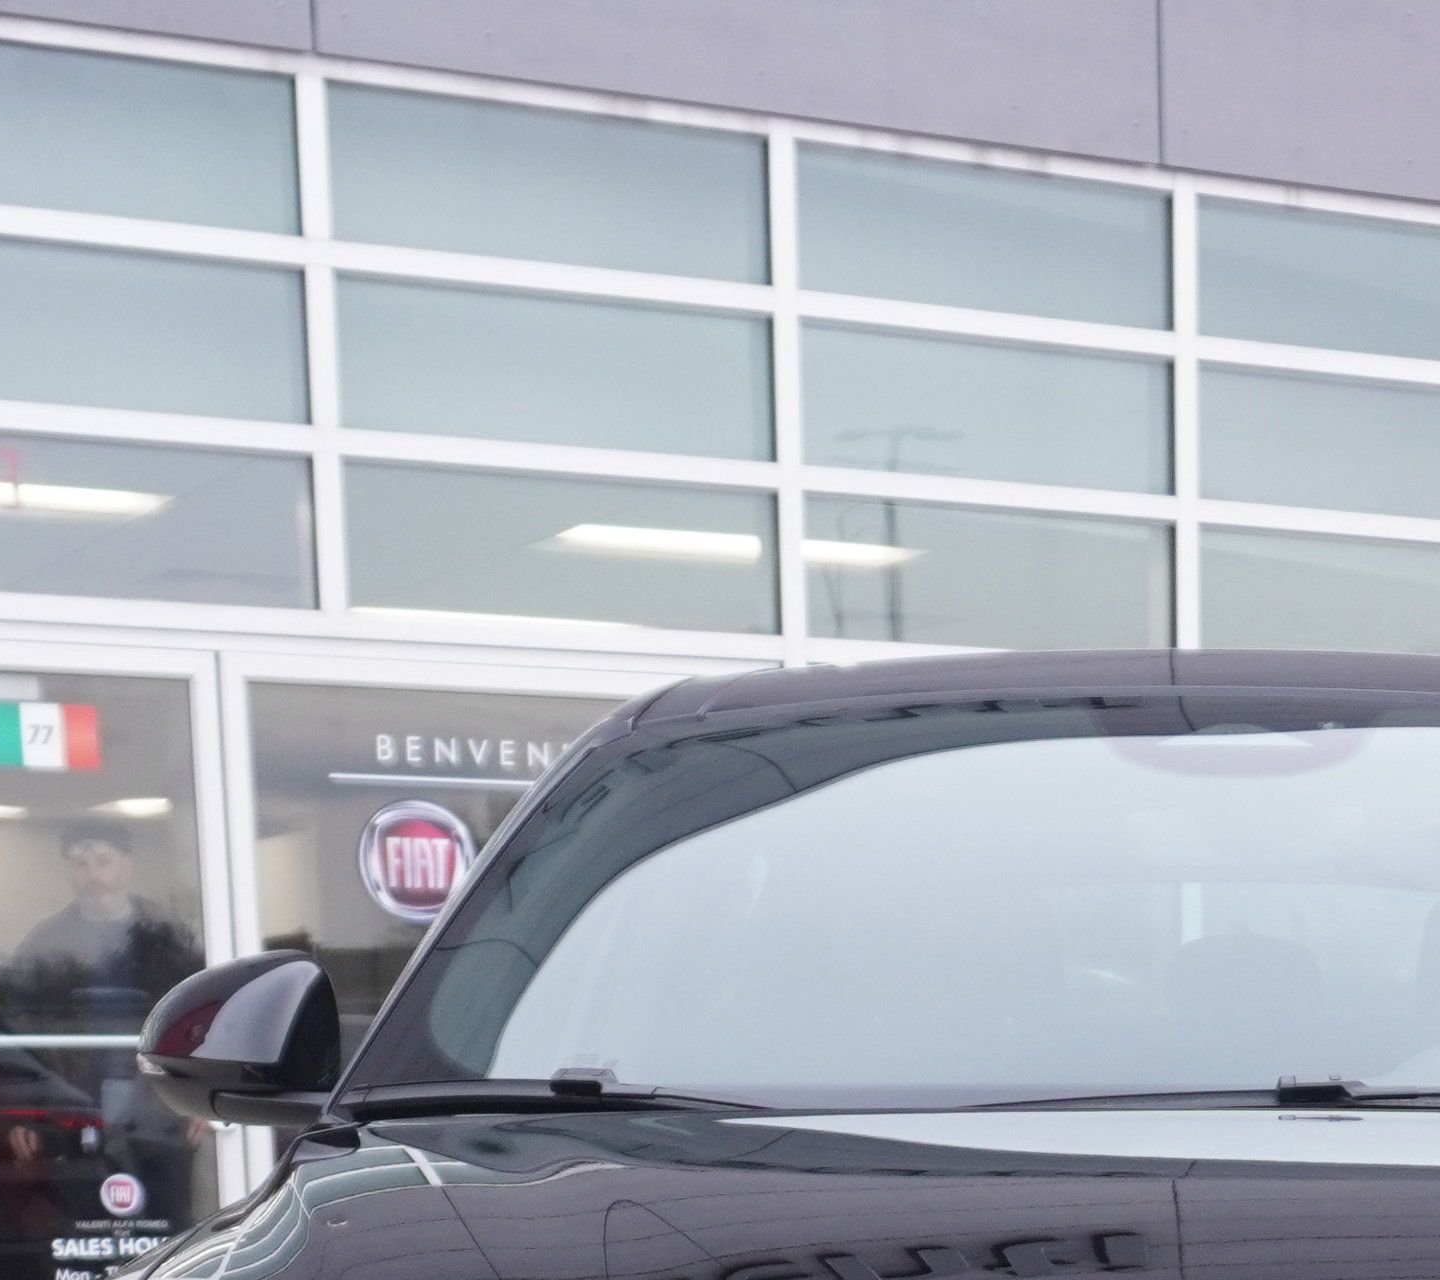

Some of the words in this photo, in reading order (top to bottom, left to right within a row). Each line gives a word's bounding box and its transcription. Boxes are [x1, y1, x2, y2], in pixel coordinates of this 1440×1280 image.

[27, 724, 54, 745] 77
[375, 734, 569, 768] BENVEN
[385, 836, 451, 889] FIAT
[51, 1238, 114, 1257] SALES
